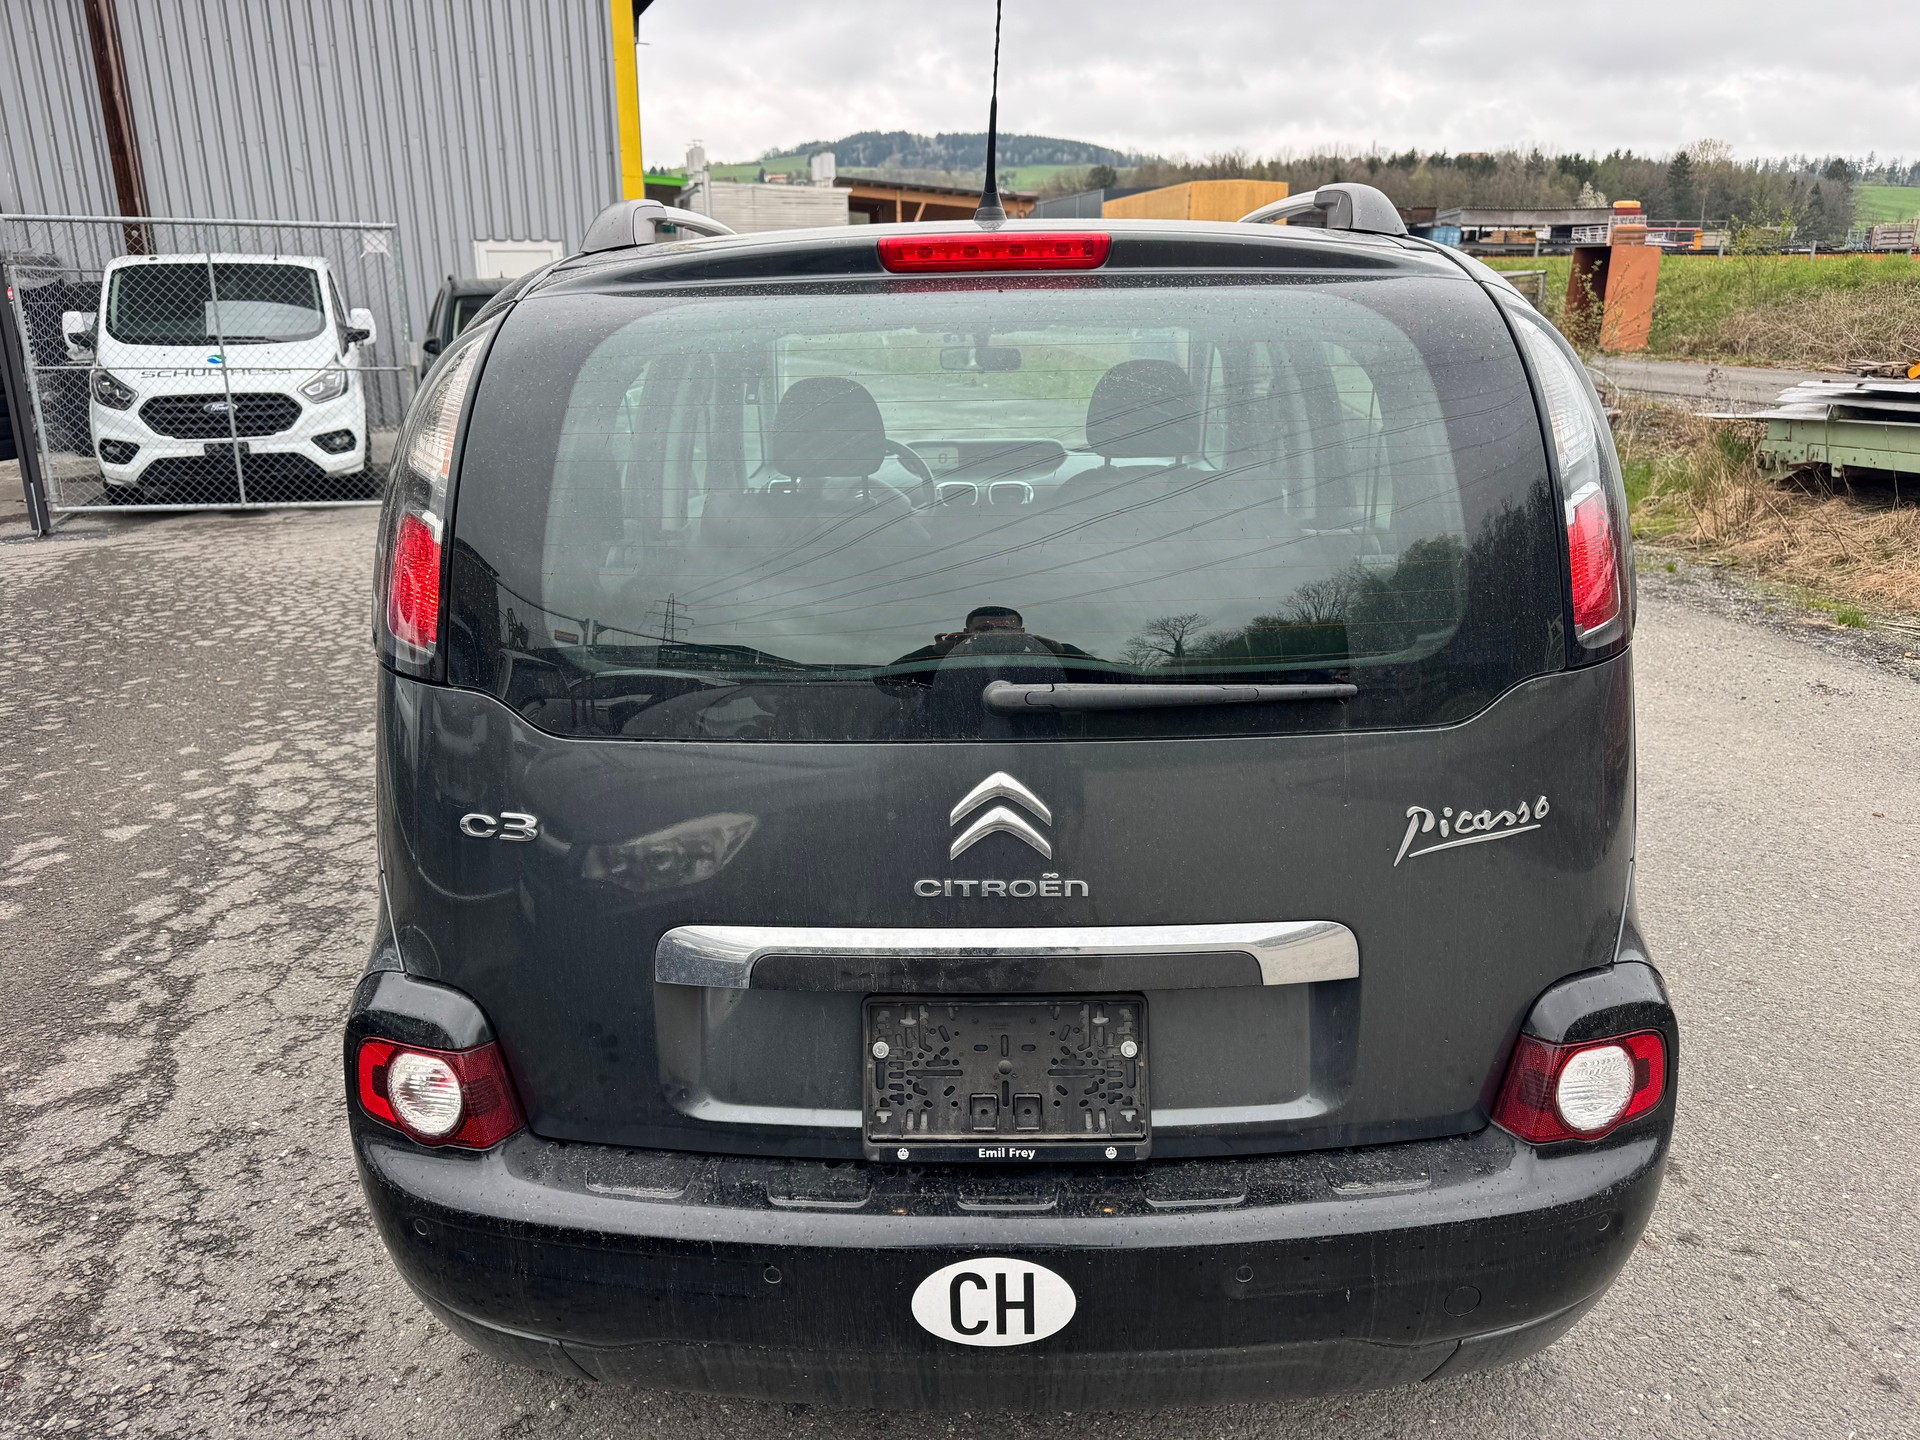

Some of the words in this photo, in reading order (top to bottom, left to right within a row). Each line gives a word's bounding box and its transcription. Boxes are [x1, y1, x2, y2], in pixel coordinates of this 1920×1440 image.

[459, 811, 538, 841] C3
[1393, 795, 1550, 866] Picasso
[978, 1147, 1006, 1158] Emil
[1009, 1147, 1036, 1160] Frey
[949, 1271, 1035, 1336] CH
